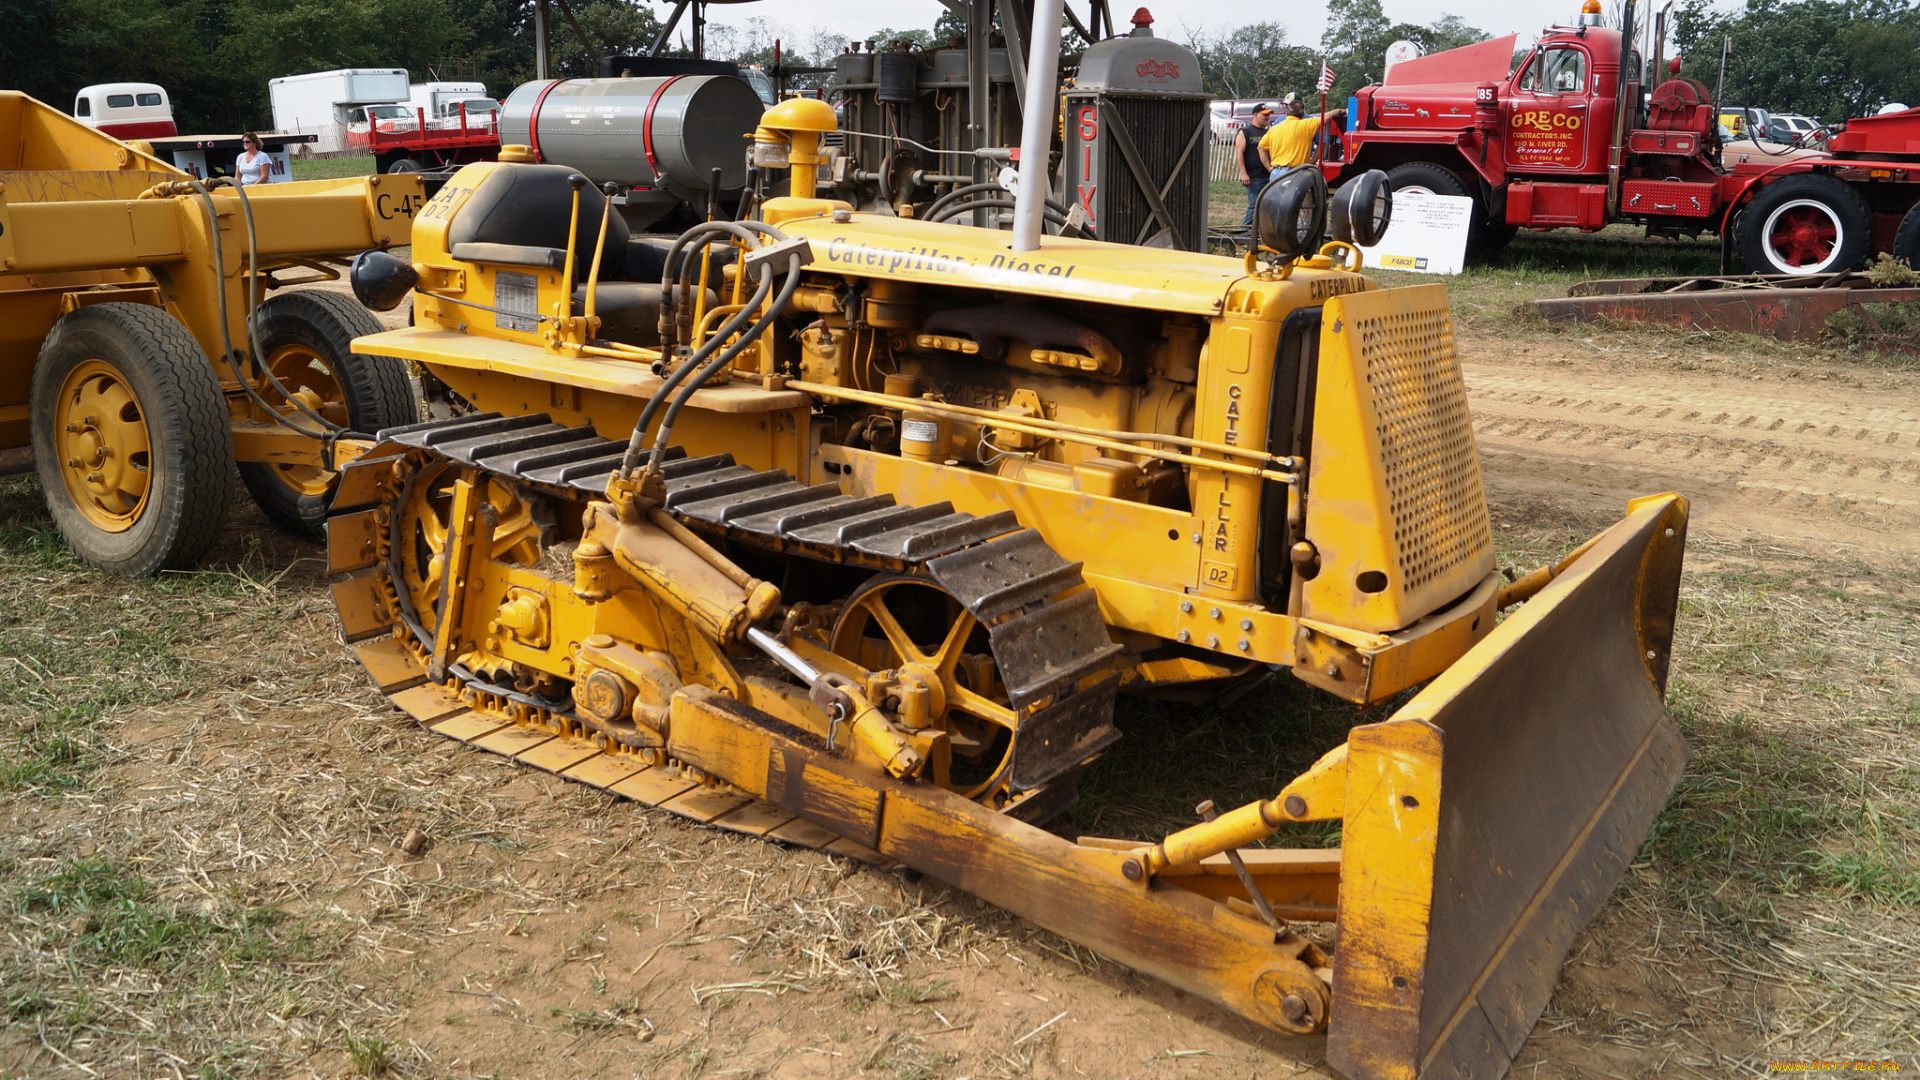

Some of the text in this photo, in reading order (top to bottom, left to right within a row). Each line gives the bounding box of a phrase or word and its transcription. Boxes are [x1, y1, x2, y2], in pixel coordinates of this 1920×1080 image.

[1477, 89, 1493, 100] 185
[1511, 111, 1581, 131] GRECO
[431, 186, 472, 204] CAT
[376, 193, 422, 220] C-45
[828, 237, 1076, 279] Caterpillar Diesel
[1390, 257, 1413, 266] FABCO
[1310, 276, 1366, 299] CATERPILLAR
[1209, 567, 1228, 583] D2
